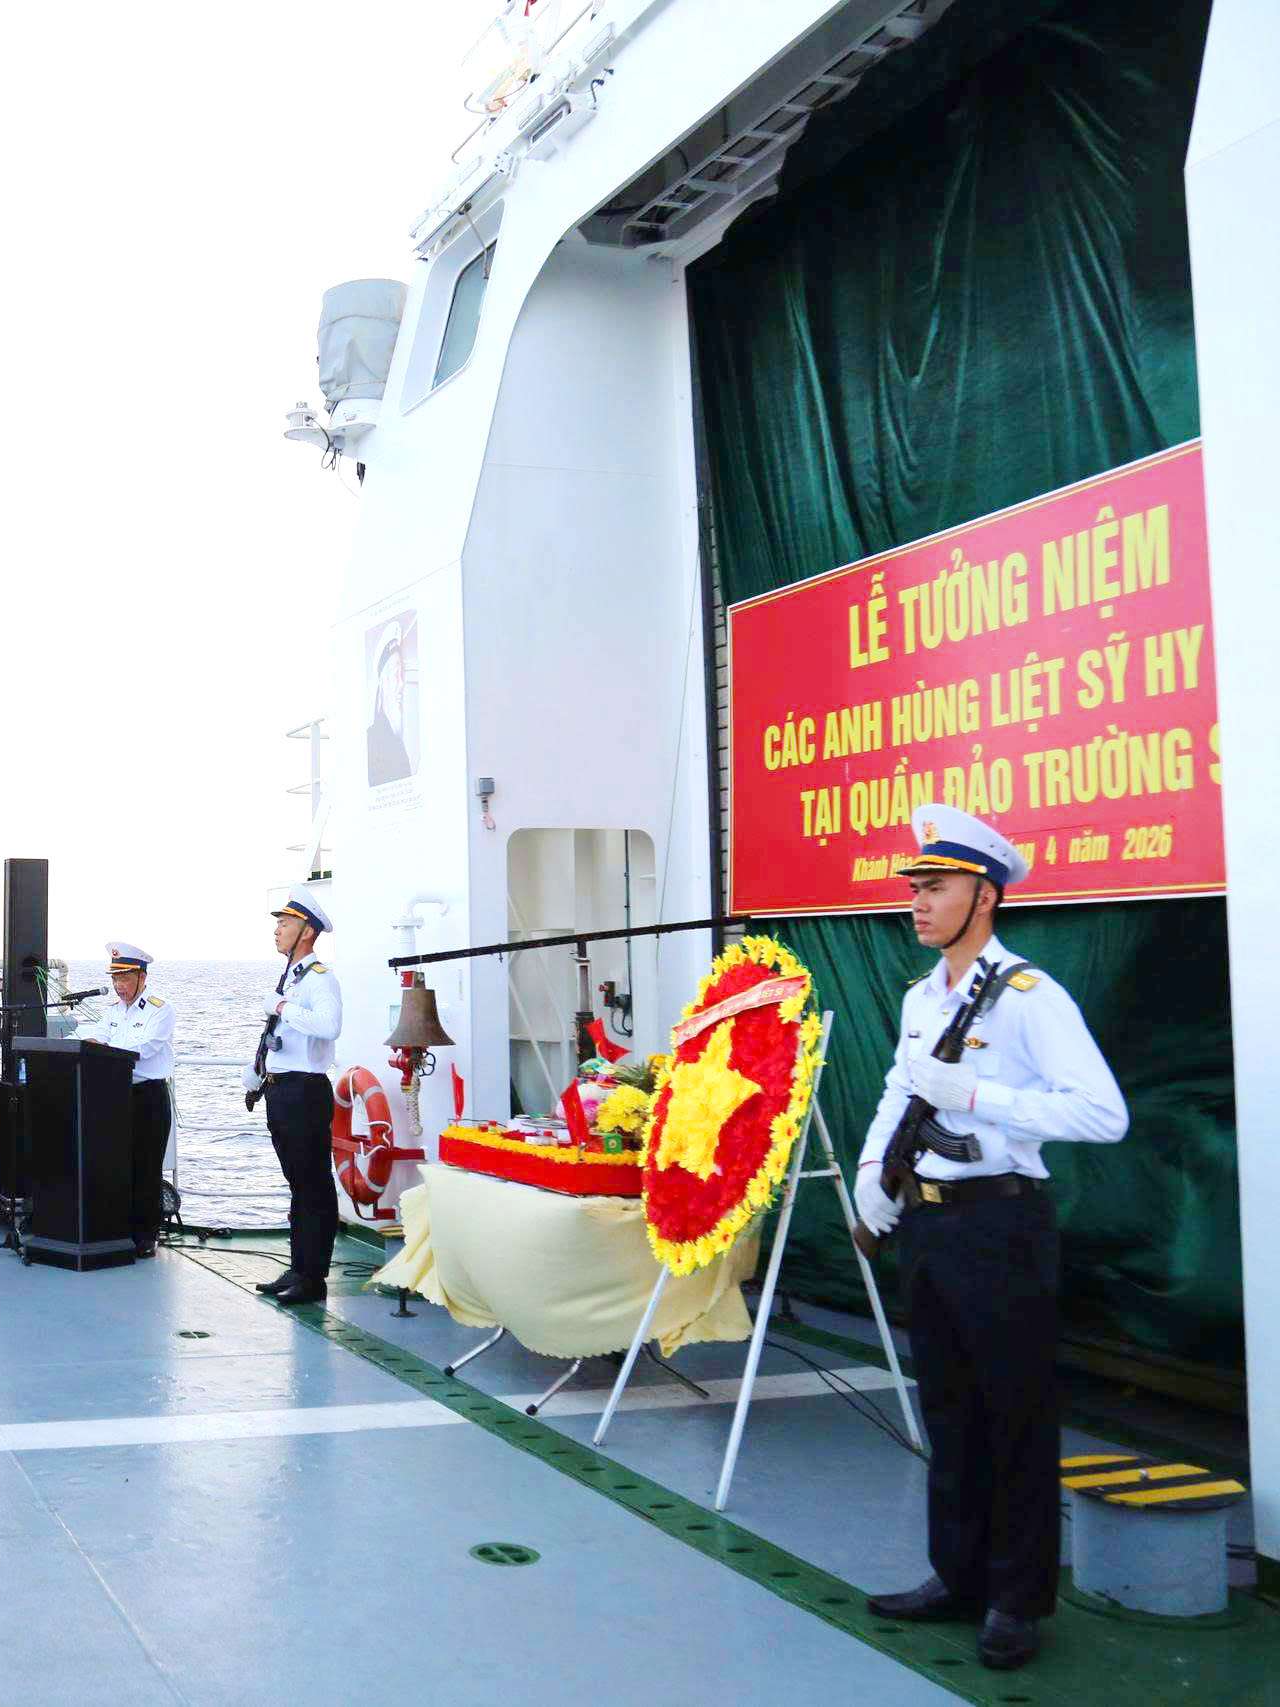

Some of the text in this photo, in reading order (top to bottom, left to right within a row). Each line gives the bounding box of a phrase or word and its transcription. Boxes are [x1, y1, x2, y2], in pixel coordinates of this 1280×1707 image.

[849, 504, 1170, 669] LỄ TƯỞNG NIỆM
[764, 624, 1205, 771] CÁC ANH HÙNG LIỆT SỸ HY
[800, 786, 841, 847] TẠI
[849, 757, 933, 836] QUẦN
[942, 743, 1013, 817] ĐẢO
[1023, 724, 1194, 809] TRƯỜNG
[852, 855, 889, 882] Khánh
[1045, 835, 1057, 865] 4
[1069, 829, 1110, 864] năm
[1121, 824, 1173, 861] 2026
